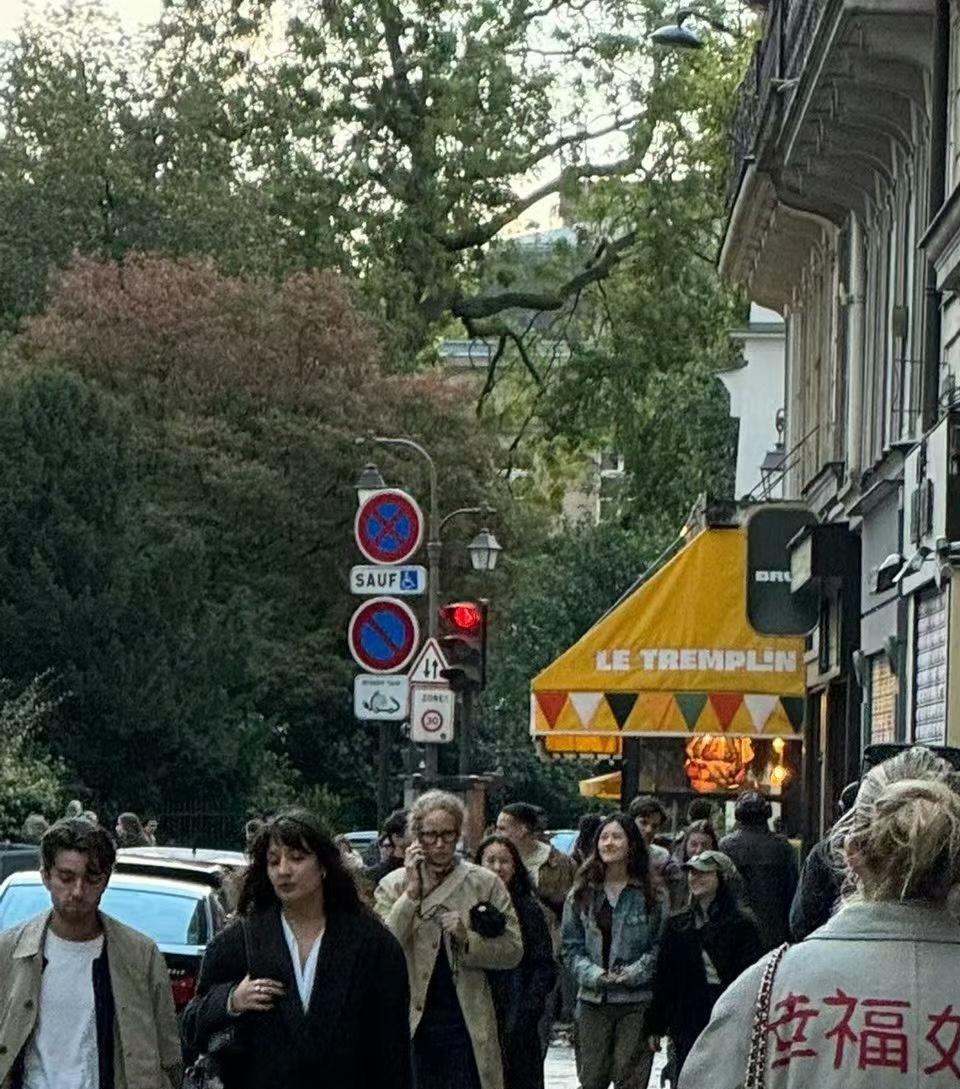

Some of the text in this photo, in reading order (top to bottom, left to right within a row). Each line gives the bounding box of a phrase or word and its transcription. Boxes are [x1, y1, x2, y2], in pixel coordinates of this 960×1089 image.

[355, 572, 398, 588] SAUF
[596, 649, 797, 672] LE TREMPLIN
